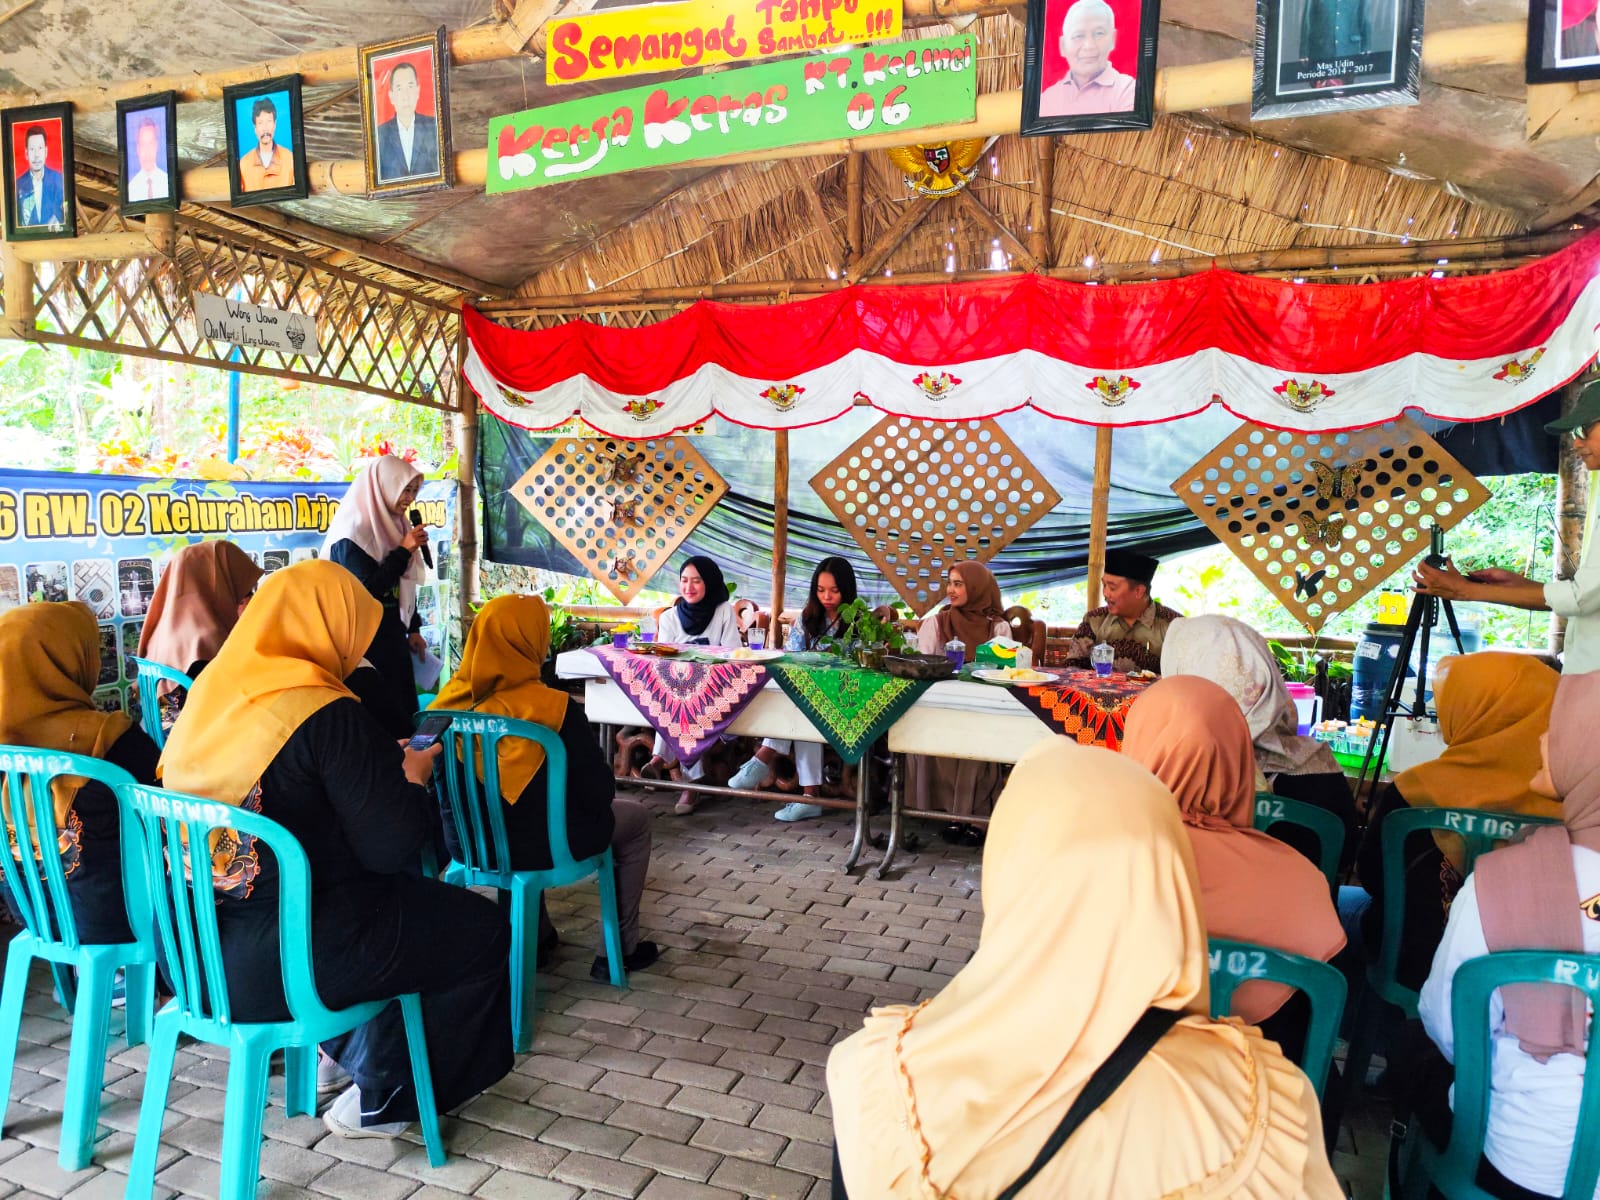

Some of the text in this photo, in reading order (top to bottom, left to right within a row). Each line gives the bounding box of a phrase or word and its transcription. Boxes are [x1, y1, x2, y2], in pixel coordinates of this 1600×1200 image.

[552, 14, 748, 80] Semangat
[1297, 70, 1326, 80] Periode
[1327, 68, 1346, 76] 2014
[1353, 63, 1374, 73] 2017
[1316, 59, 1354, 70] Mas Udin
[846, 85, 911, 131] 06
[497, 84, 789, 180] Kerja Keras
[0, 493, 18, 538] 6
[24, 492, 96, 537] RW.
[100, 492, 144, 535] 02
[149, 493, 293, 534] Kelurahan
[462, 718, 485, 733] RW
[487, 719, 509, 733] 02
[14, 753, 44, 774] RW
[171, 799, 201, 822] RW
[202, 804, 232, 825] 02
[1256, 800, 1285, 818] 02
[1444, 811, 1515, 837] RT 06
[1228, 951, 1268, 978] 02
